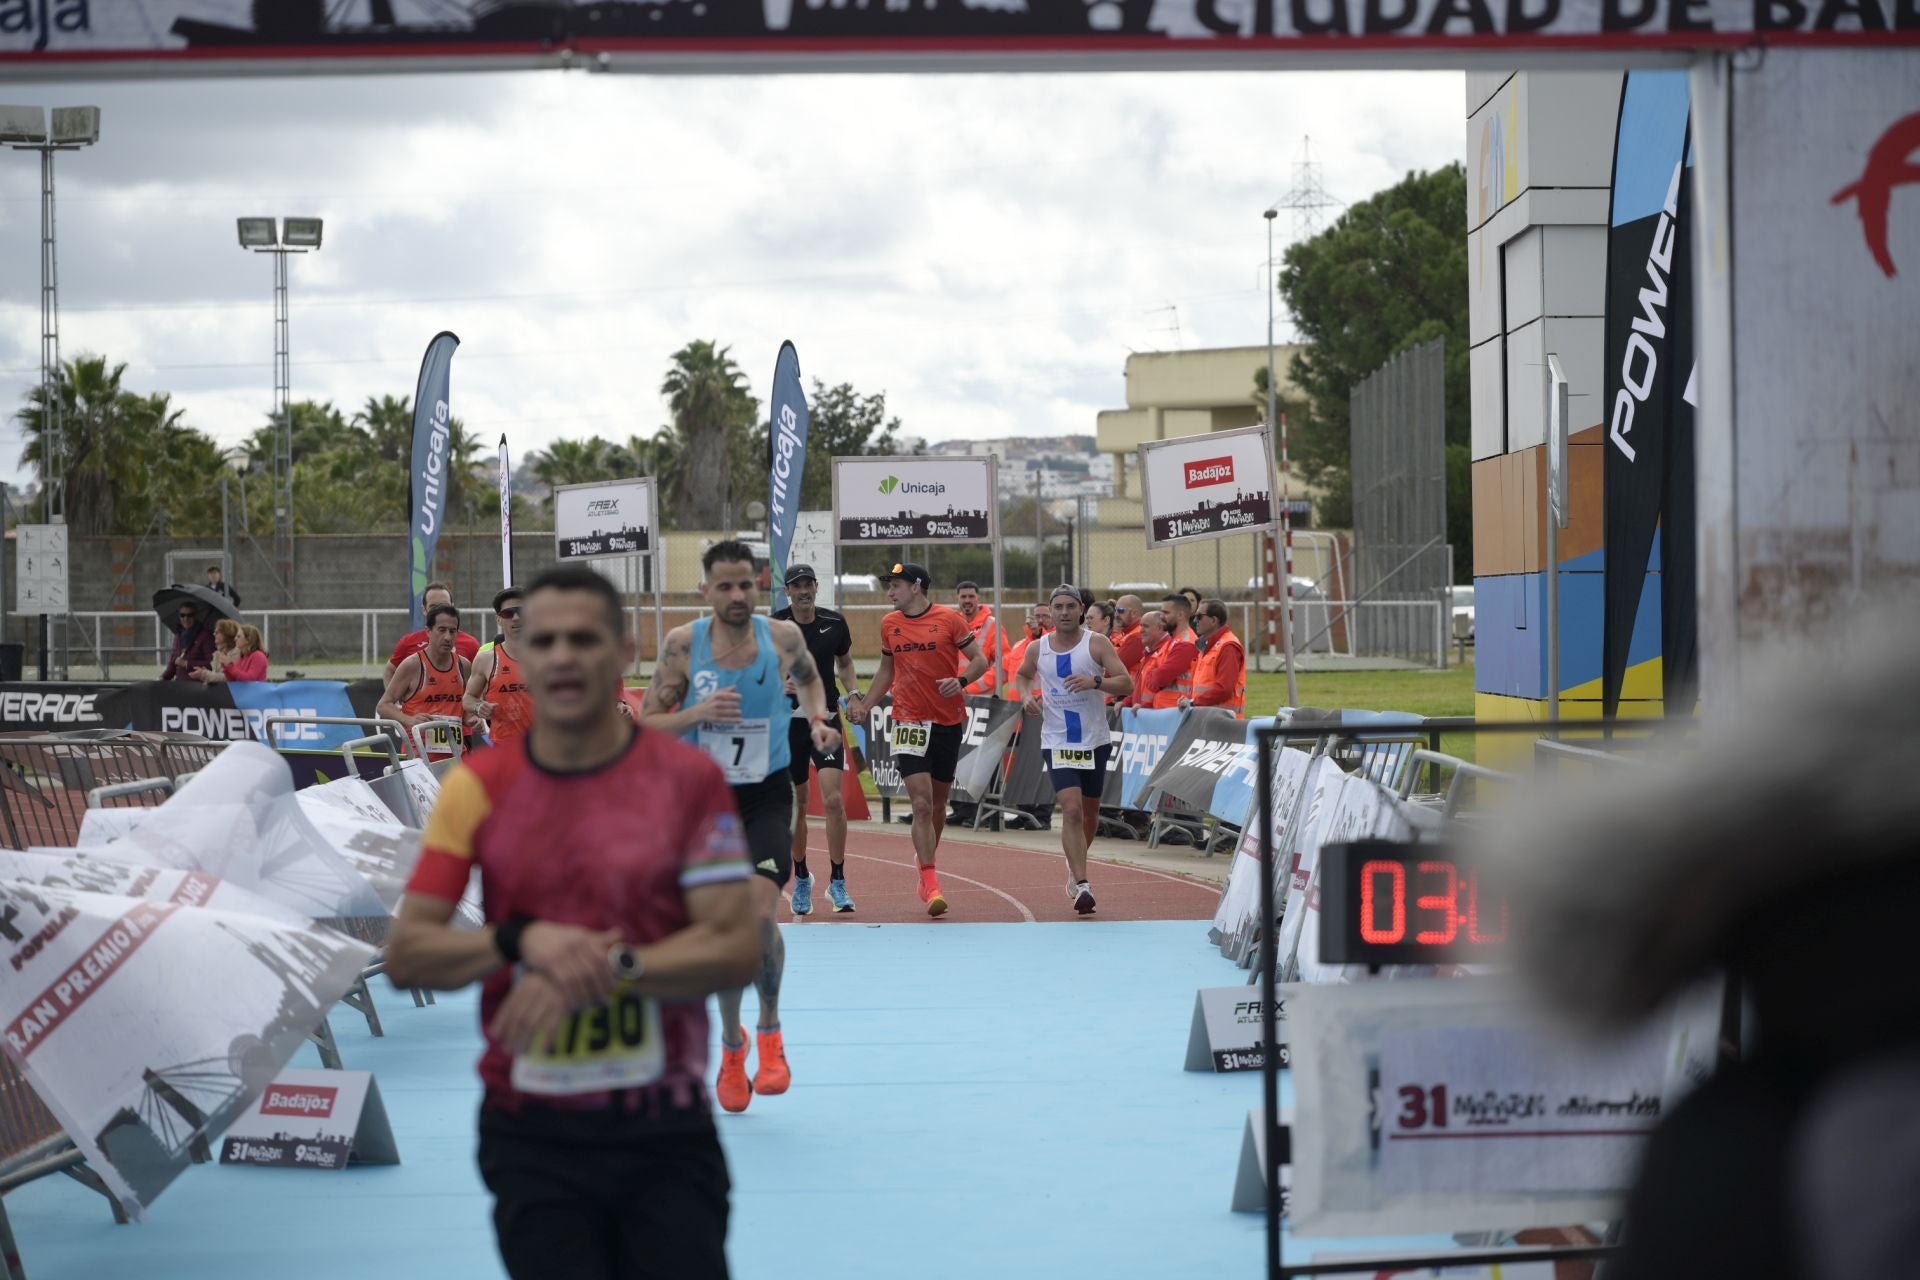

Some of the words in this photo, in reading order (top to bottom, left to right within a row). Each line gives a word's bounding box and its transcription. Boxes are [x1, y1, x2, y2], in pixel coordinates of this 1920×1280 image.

[1601, 0, 1715, 33] DE
[1189, 465, 1231, 482] Badajoz
[901, 482, 945, 496] Unicaja
[1220, 509, 1230, 527] 9
[859, 522, 877, 538] 31
[926, 520, 937, 536] 9
[1168, 519, 1183, 538] 31
[570, 541, 581, 555] 31
[609, 537, 616, 551] 9
[0, 692, 98, 722] ERADE
[161, 707, 319, 741] POWERADE
[895, 727, 927, 747] 1063
[732, 736, 745, 766] 7
[7, 998, 59, 1052] RAN
[54, 928, 131, 1007] PREMIO
[1234, 999, 1287, 1015] FAX
[1222, 1053, 1240, 1070] 31
[1279, 1048, 1290, 1064] 9
[269, 1092, 331, 1113] Badajoz
[1397, 1084, 1448, 1130] 31
[228, 1142, 249, 1161] 31
[295, 1144, 306, 1163] 9
